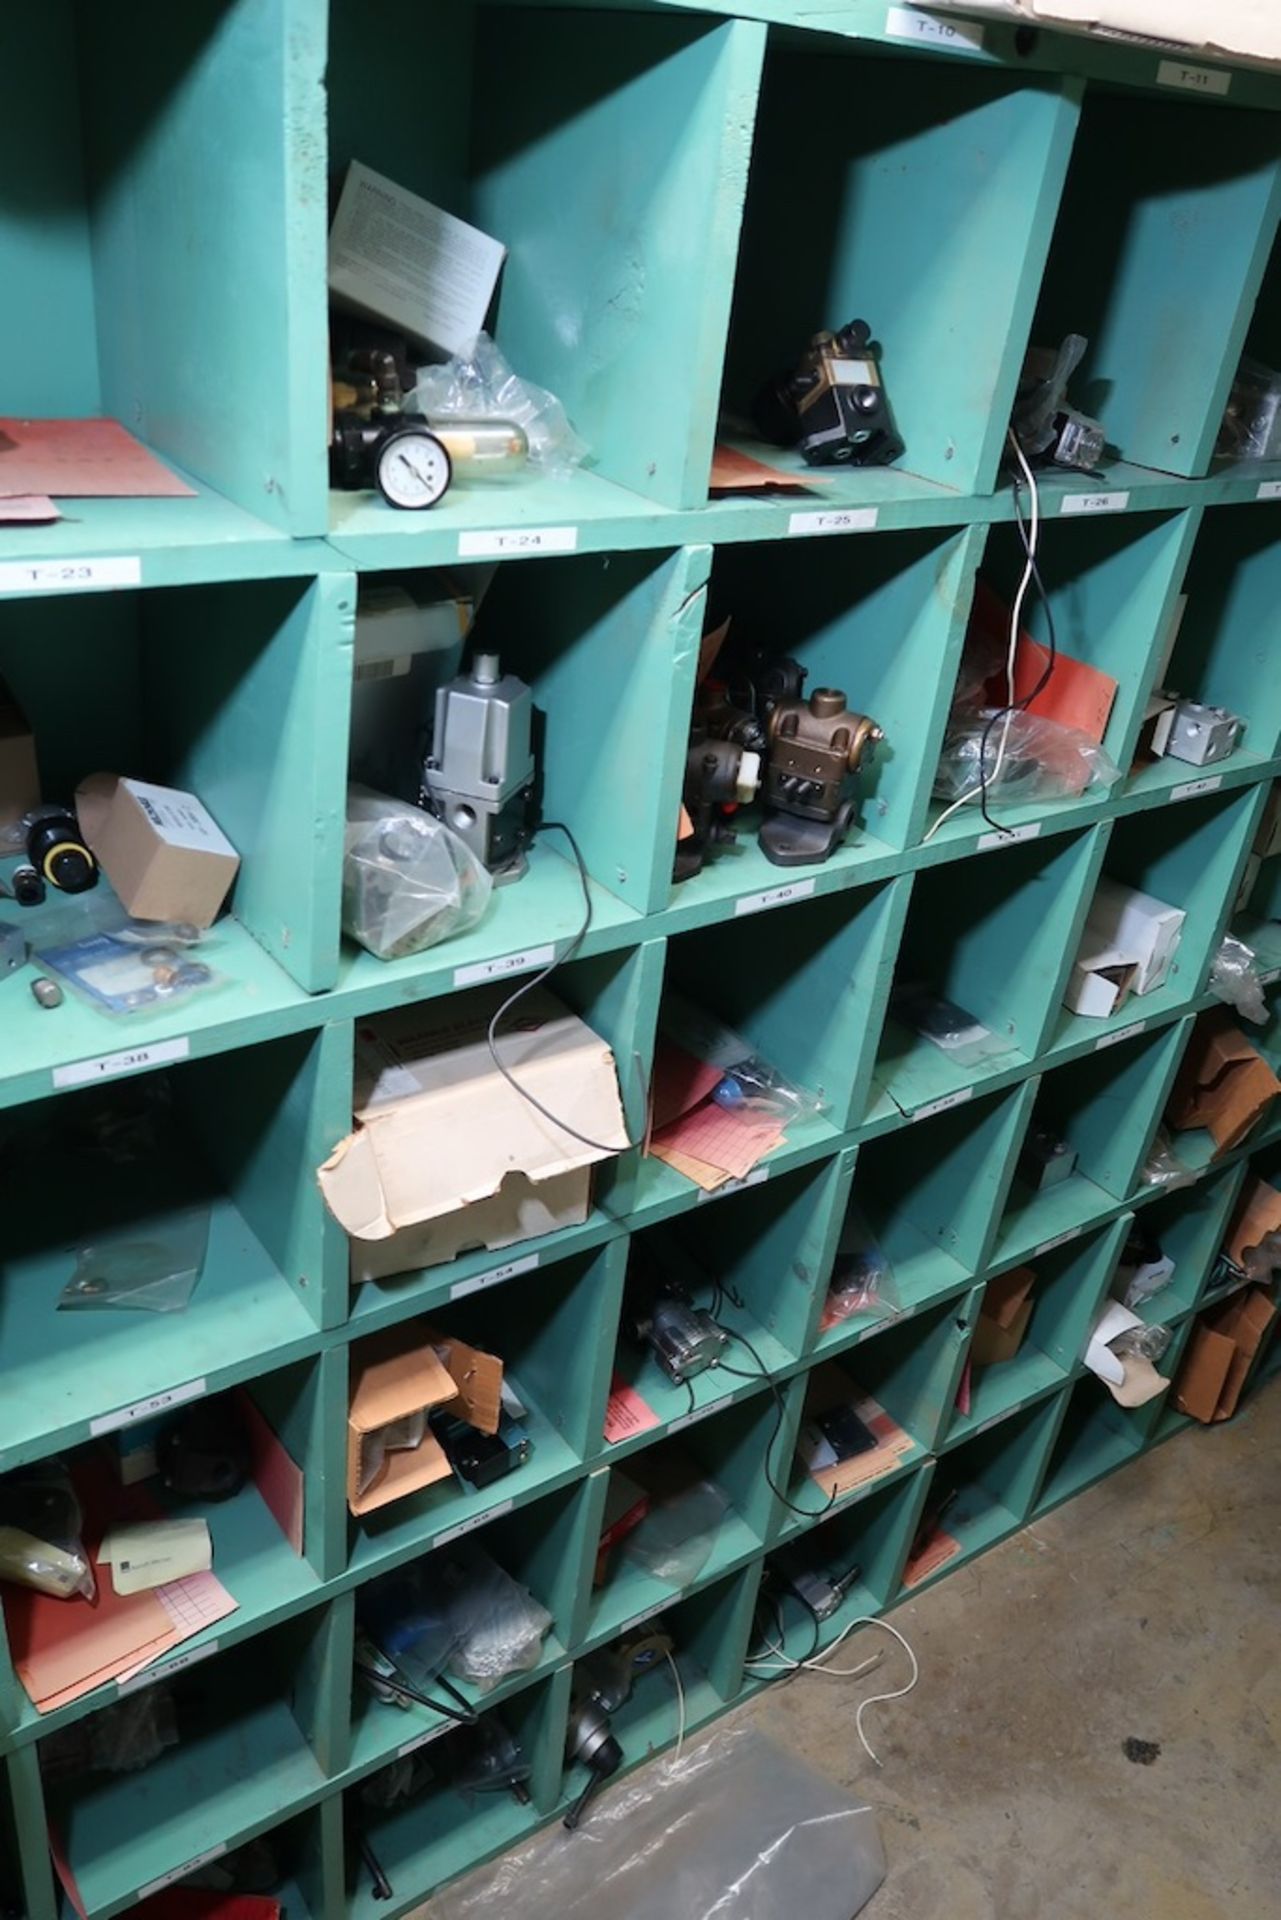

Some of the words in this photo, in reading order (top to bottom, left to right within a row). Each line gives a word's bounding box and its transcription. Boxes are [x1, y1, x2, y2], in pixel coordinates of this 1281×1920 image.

[916, 19, 957, 37] T-10
[1180, 70, 1209, 85] T-11
[1082, 498, 1110, 507] T-26
[816, 516, 852, 526] T-25
[496, 535, 541, 547] T-24
[26, 567, 93, 580] T-23
[762, 889, 793, 903] T-40
[484, 958, 526, 973] T-39
[95, 1053, 149, 1071] T-38
[480, 1267, 513, 1284] T-54
[127, 1396, 172, 1417] T-53
